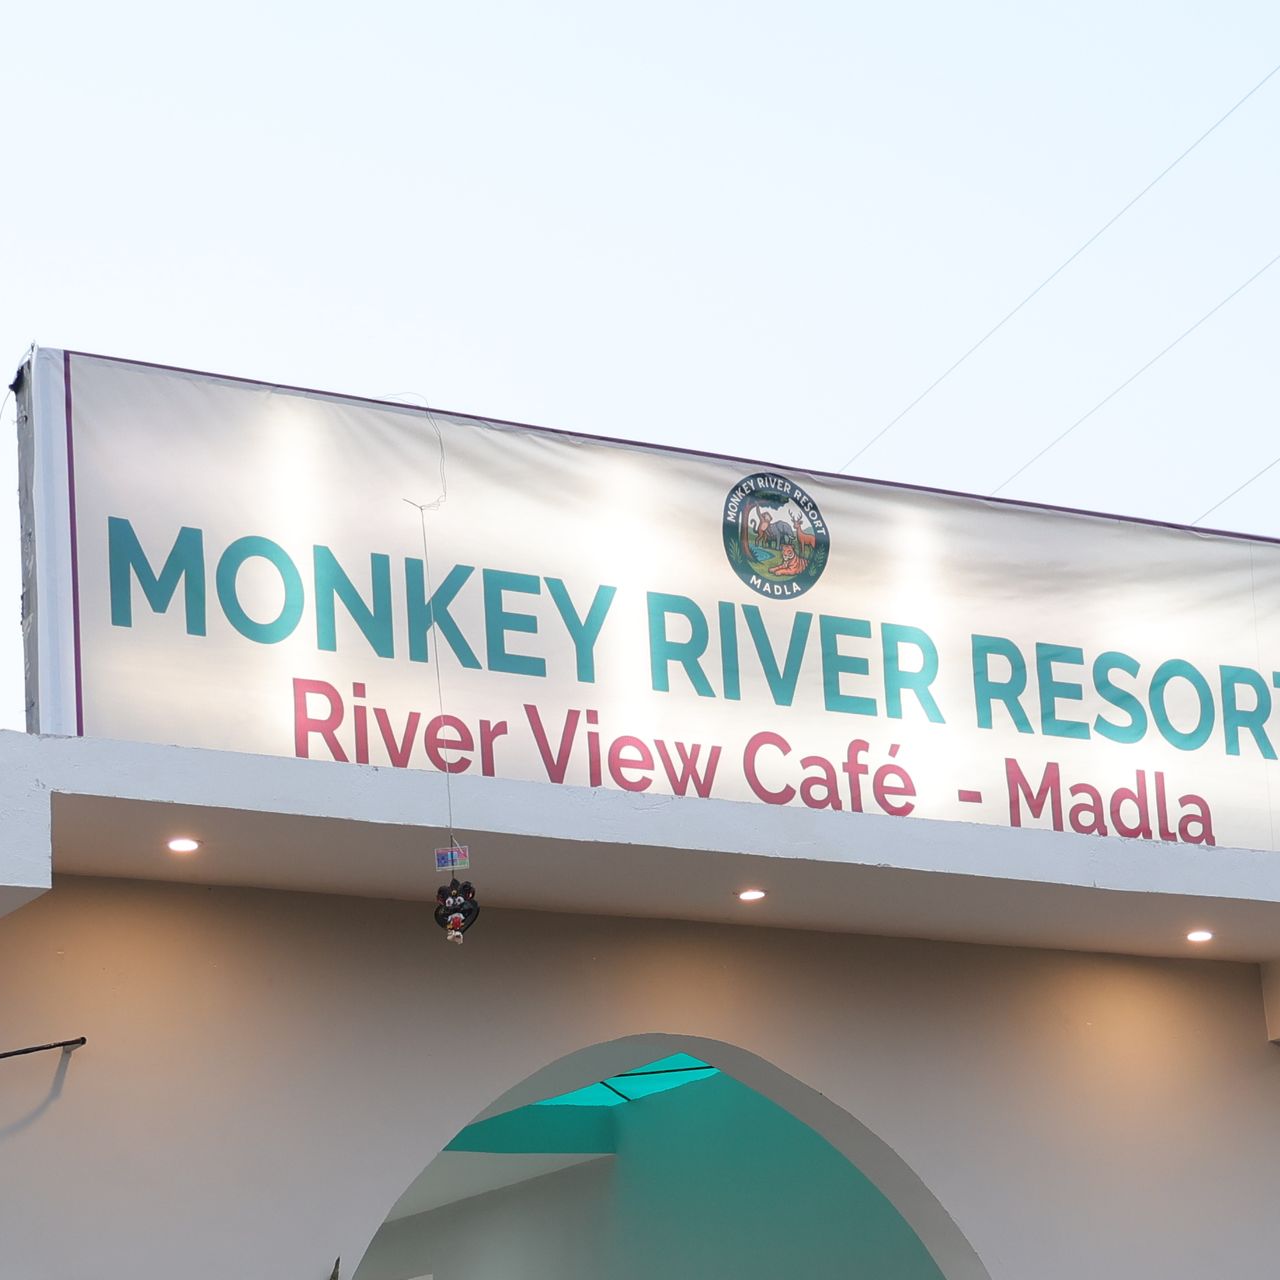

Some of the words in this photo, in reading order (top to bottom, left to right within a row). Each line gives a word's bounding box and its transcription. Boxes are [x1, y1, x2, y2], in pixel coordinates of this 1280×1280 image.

[727, 479, 755, 523] MONKEY
[757, 477, 791, 494] RIVER
[793, 490, 826, 536] RESORT
[107, 515, 616, 684] MONKEY
[646, 591, 946, 725] RIVER
[749, 575, 802, 595] MADLA
[292, 677, 508, 778] River
[523, 703, 722, 798] View
[742, 730, 917, 818] Café
[1004, 757, 1217, 846] Madla
